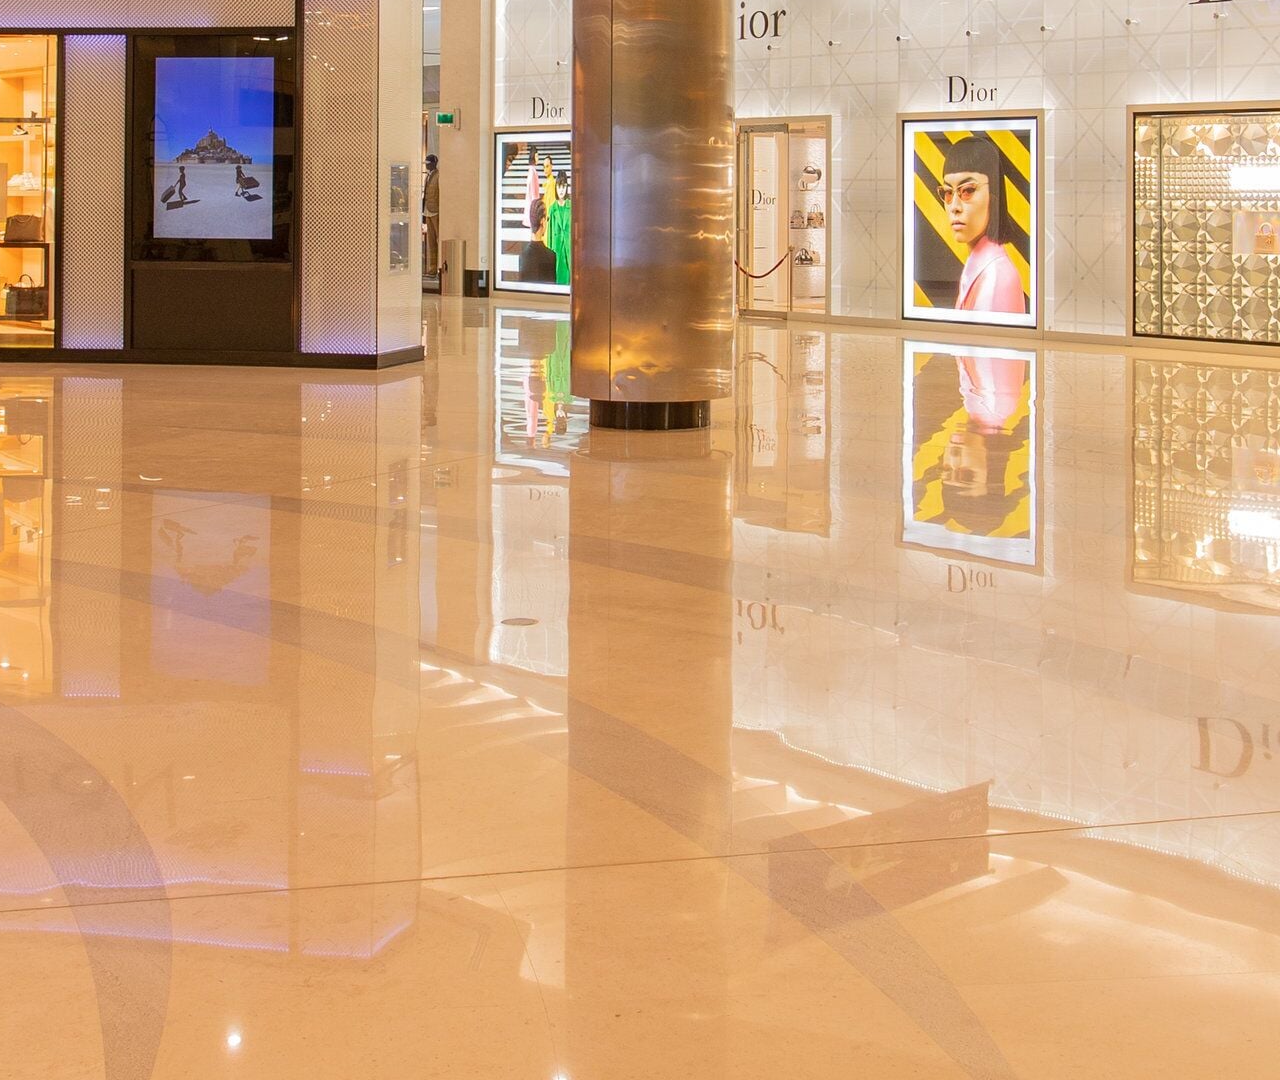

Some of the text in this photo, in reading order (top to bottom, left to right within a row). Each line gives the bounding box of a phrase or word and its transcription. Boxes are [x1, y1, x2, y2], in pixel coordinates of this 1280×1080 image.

[736, 1, 787, 40] ior
[945, 75, 998, 104] Dior
[530, 96, 565, 119] Dior
[751, 189, 776, 205] Dior
